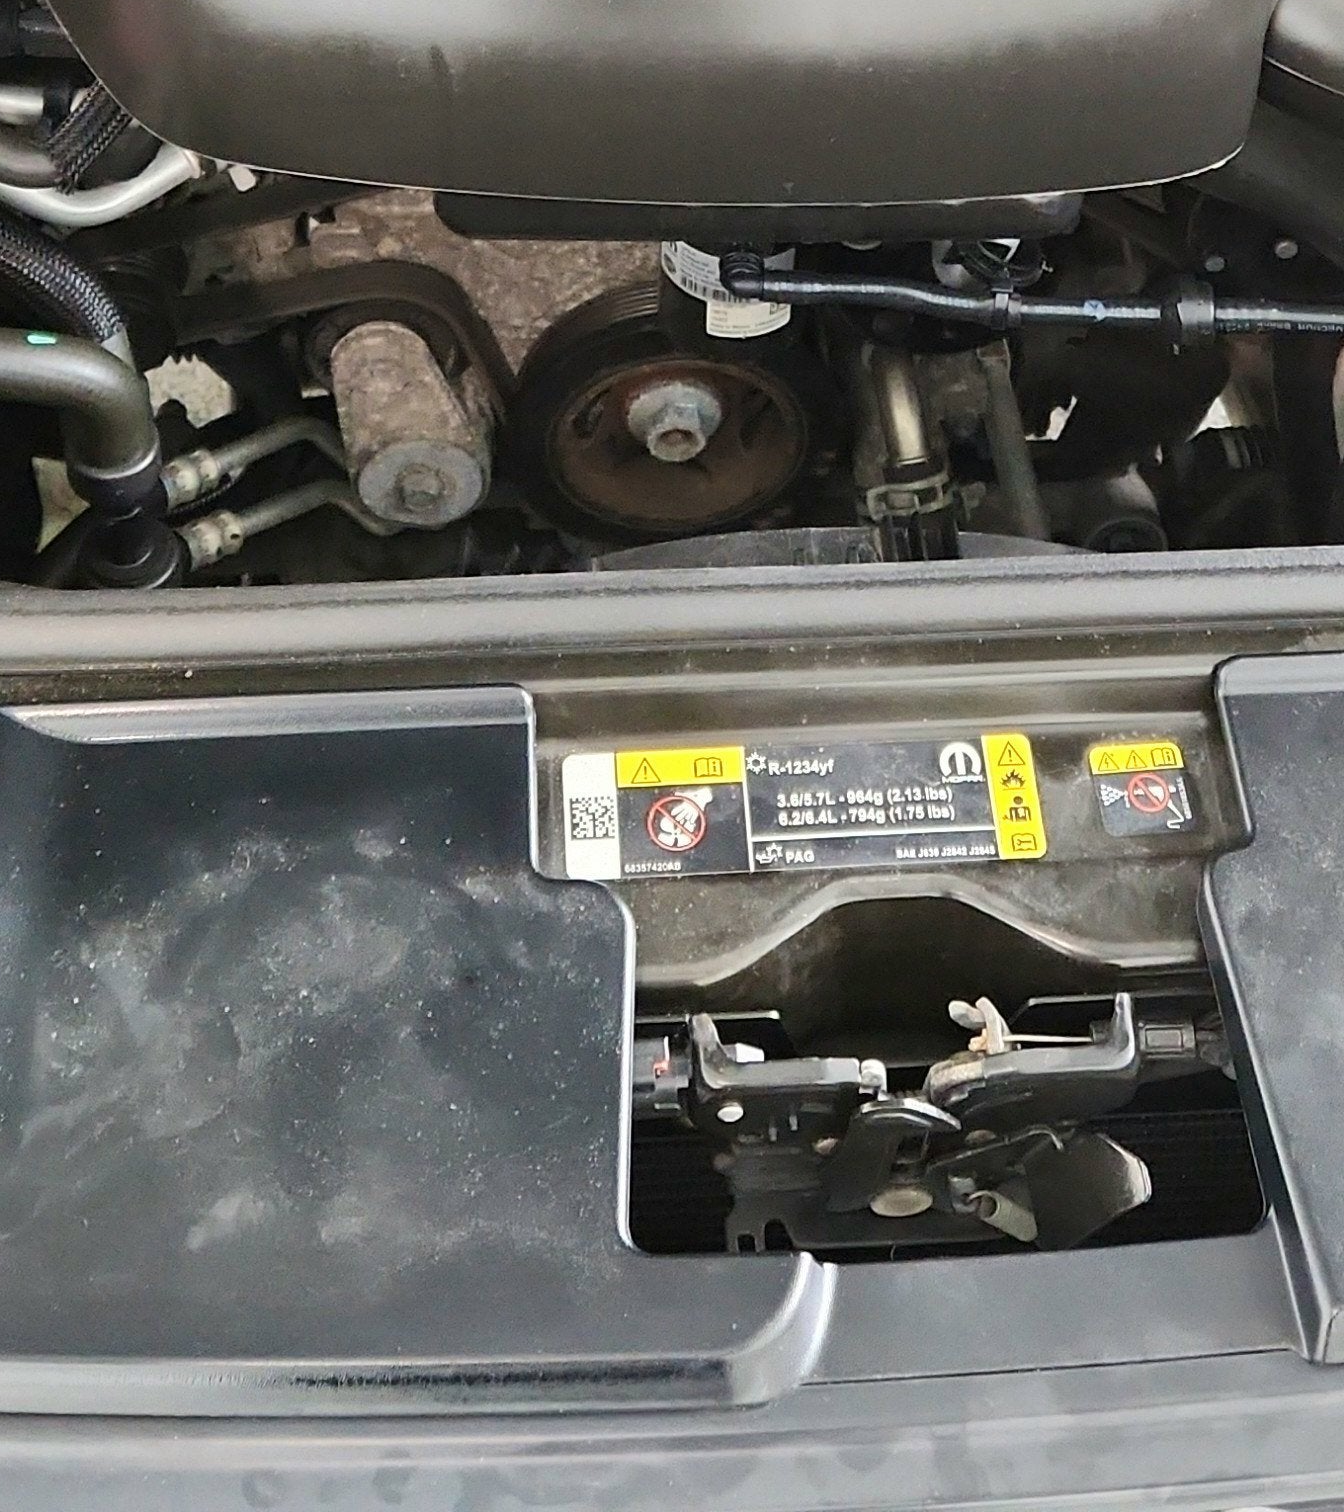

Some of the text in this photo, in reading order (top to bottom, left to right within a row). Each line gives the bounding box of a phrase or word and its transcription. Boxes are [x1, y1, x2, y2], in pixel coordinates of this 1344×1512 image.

[768, 758, 834, 776] R-1234yf
[776, 792, 836, 808] 3.6/5.7L
[846, 789, 884, 807] 964g
[887, 788, 922, 805] (2.13
[924, 787, 953, 804] lbs)
[778, 810, 838, 826] 6.2/6.4L
[848, 807, 886, 824] 794g
[889, 805, 925, 823] (1.75
[927, 804, 956, 820] lbs)
[785, 851, 815, 863] PAG
